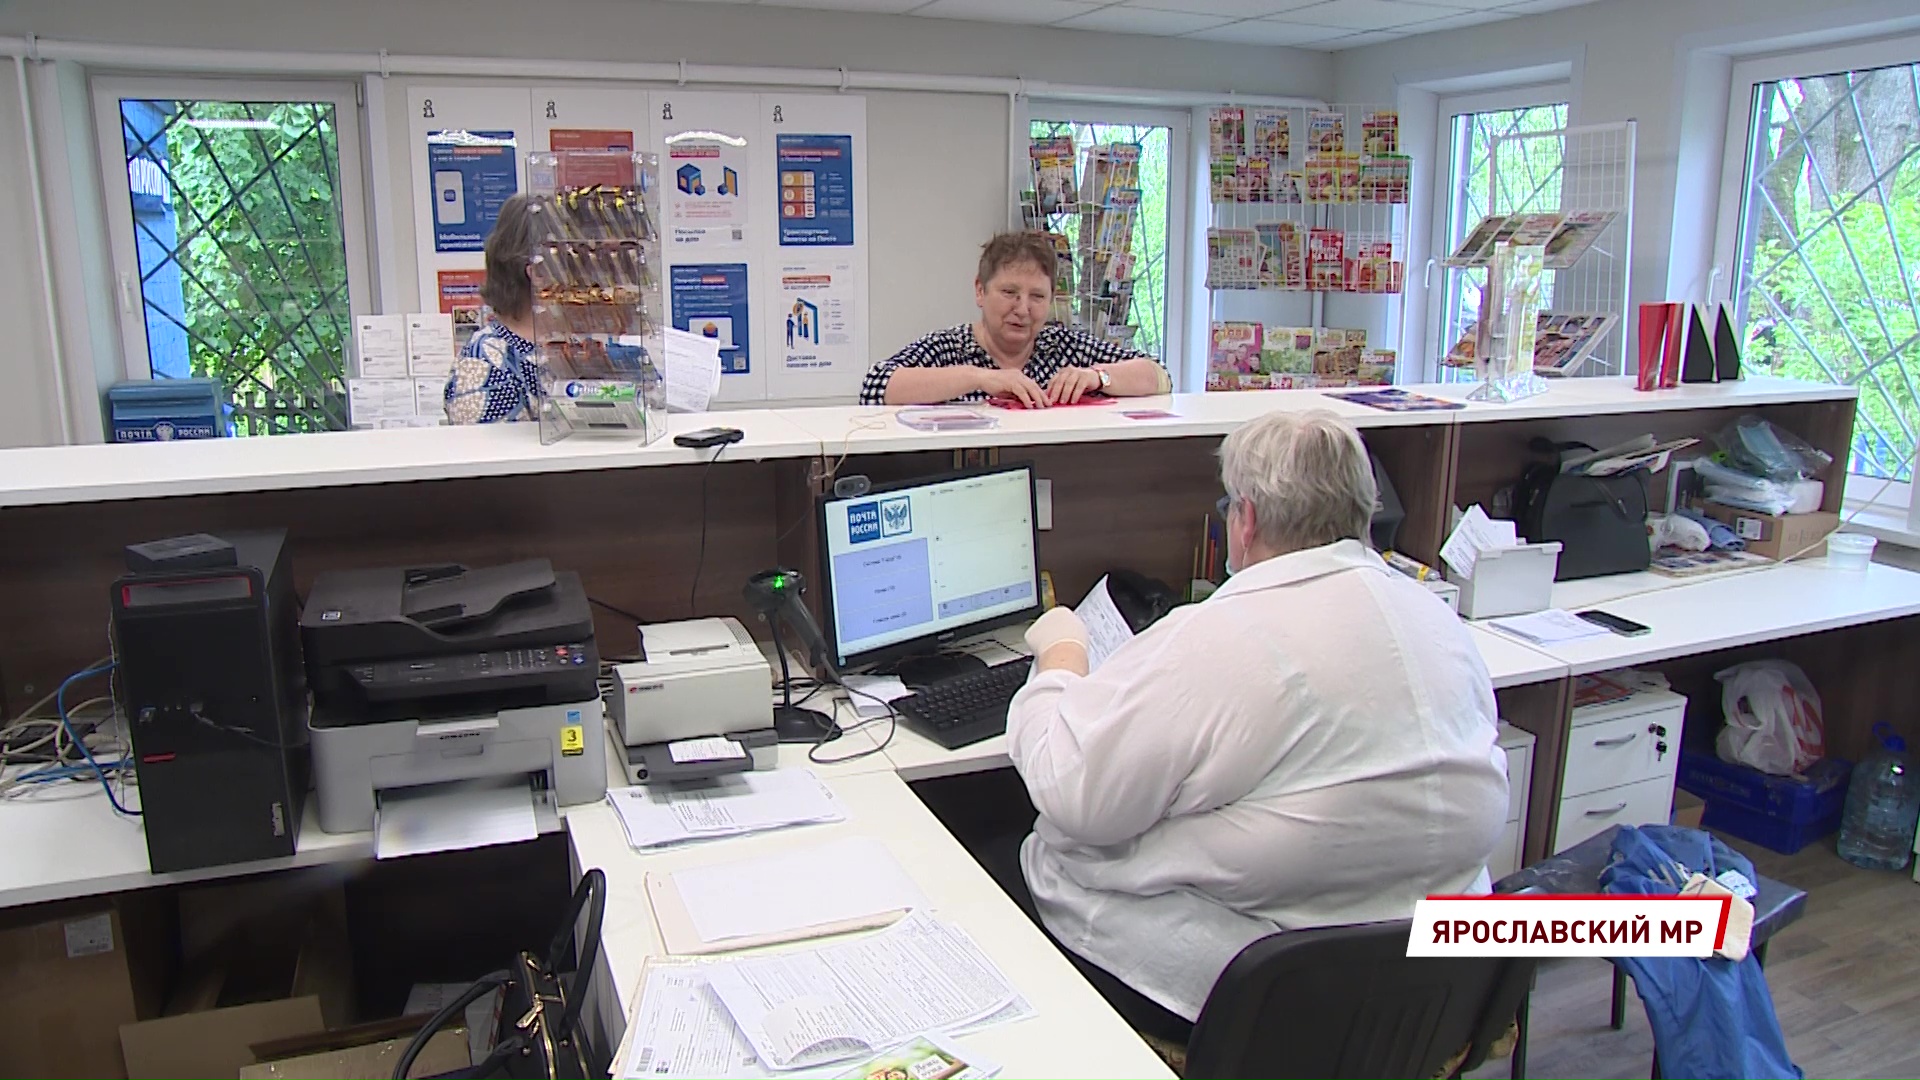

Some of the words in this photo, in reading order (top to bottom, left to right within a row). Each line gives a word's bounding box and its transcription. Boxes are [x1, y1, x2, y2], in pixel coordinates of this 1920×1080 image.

[120, 430, 153, 439] ПОЧТА
[178, 428, 210, 436] РОССИИ
[850, 510, 877, 524] ПОЧТА
[851, 523, 878, 536] РОССИИ
[566, 728, 577, 742] 3
